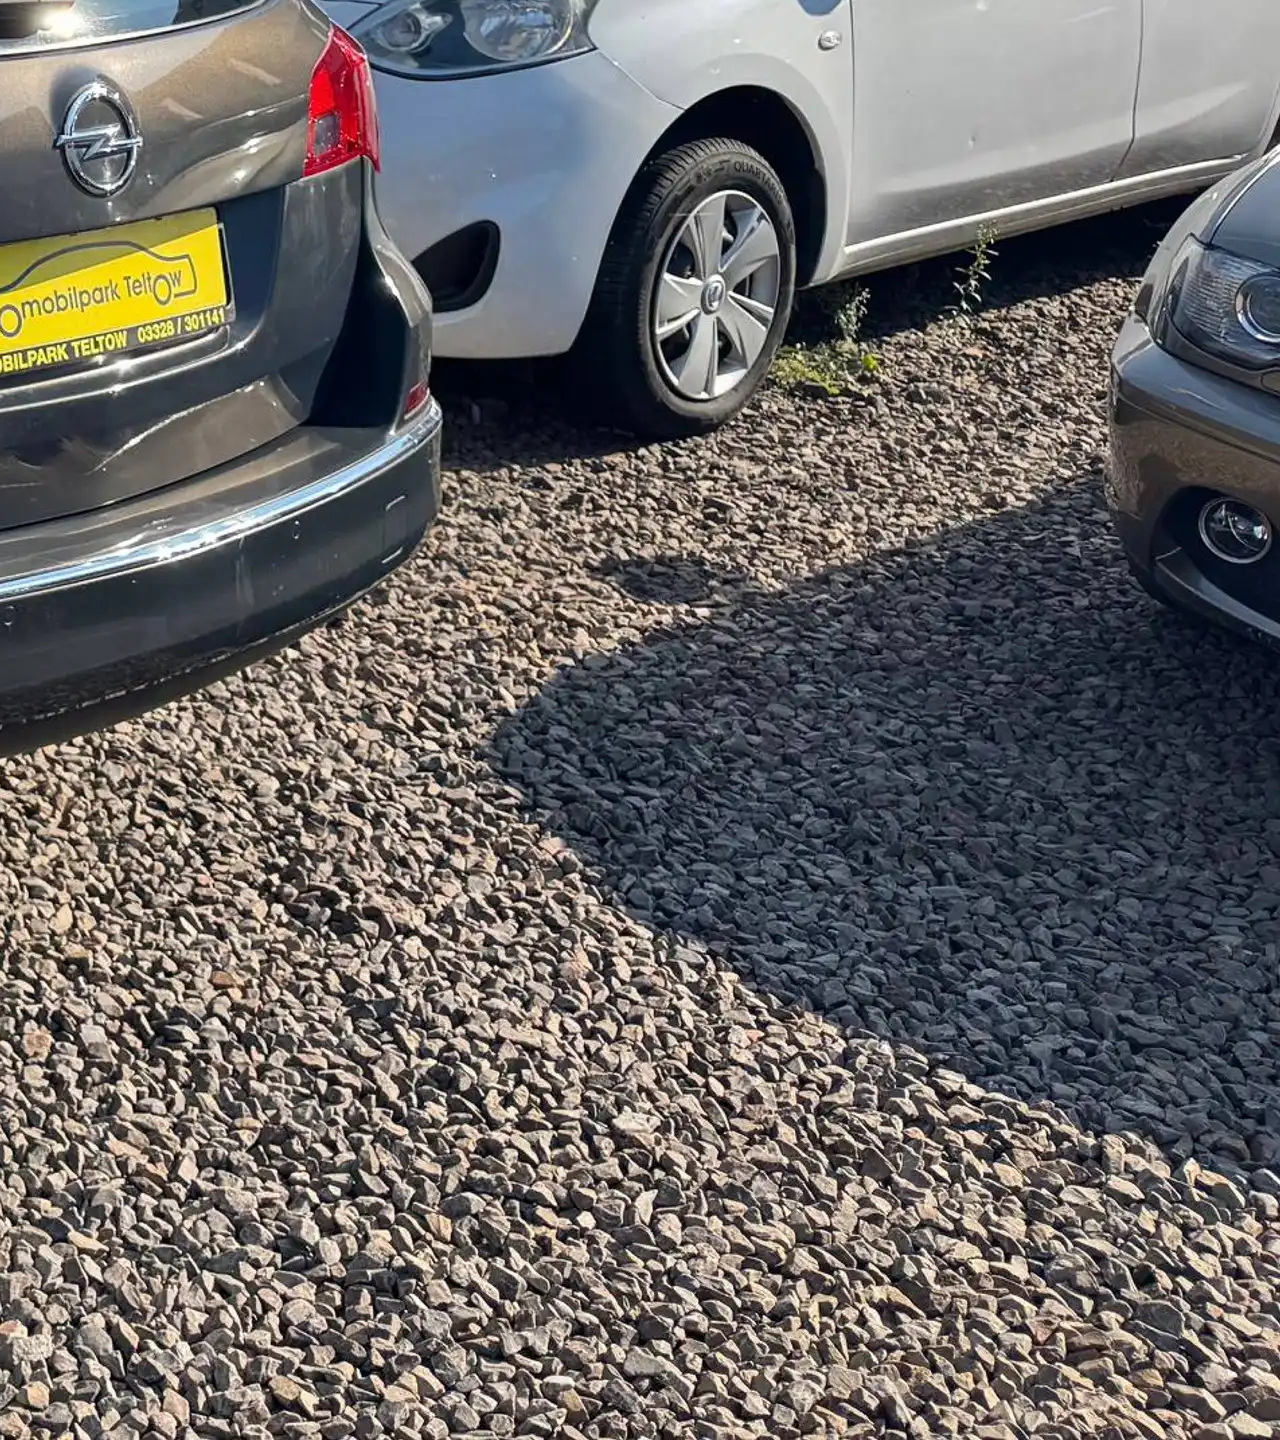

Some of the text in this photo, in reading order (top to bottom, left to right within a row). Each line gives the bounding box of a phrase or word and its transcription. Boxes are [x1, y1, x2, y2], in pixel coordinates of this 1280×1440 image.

[124, 269, 182, 306] Teltow
[72, 330, 128, 358] TELTOW
[137, 321, 174, 343] 03328
[184, 308, 226, 332] 301141
